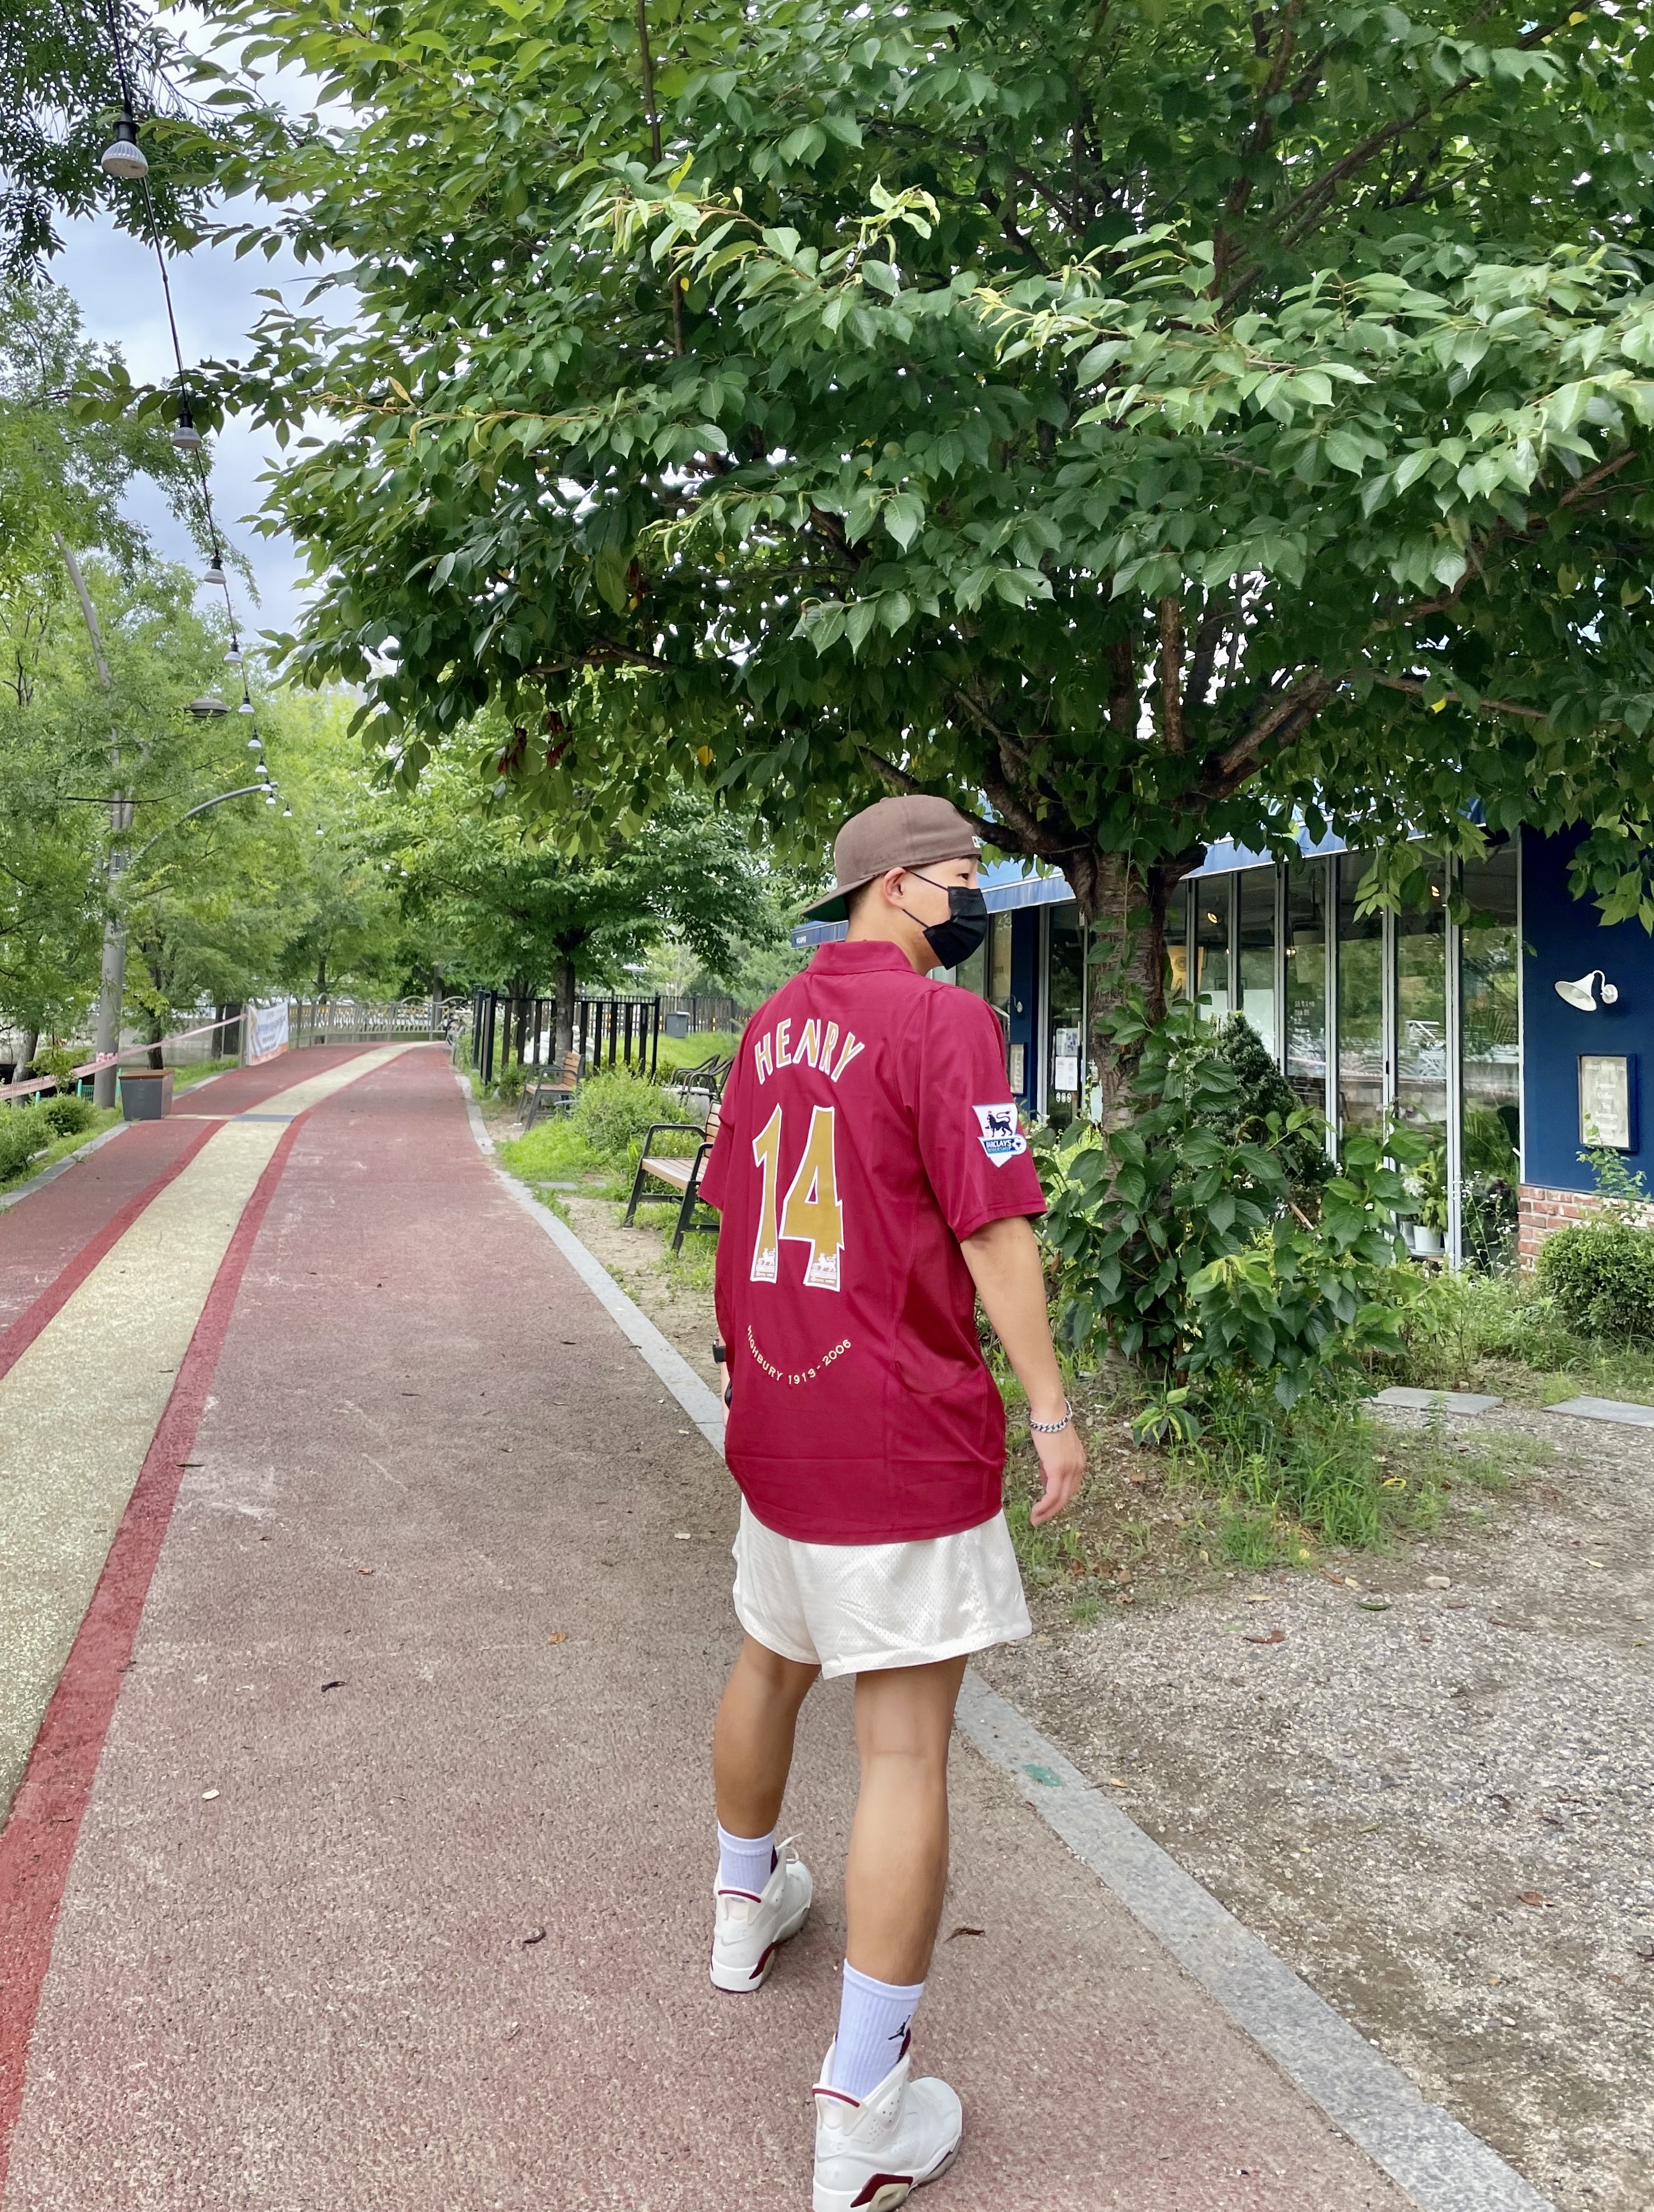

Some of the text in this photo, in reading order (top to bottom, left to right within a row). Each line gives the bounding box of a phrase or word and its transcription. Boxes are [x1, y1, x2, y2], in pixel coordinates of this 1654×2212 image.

[755, 1018, 865, 1085] HENRY
[750, 1103, 844, 1292] 14
[747, 1325, 783, 1381] HIGHBURY
